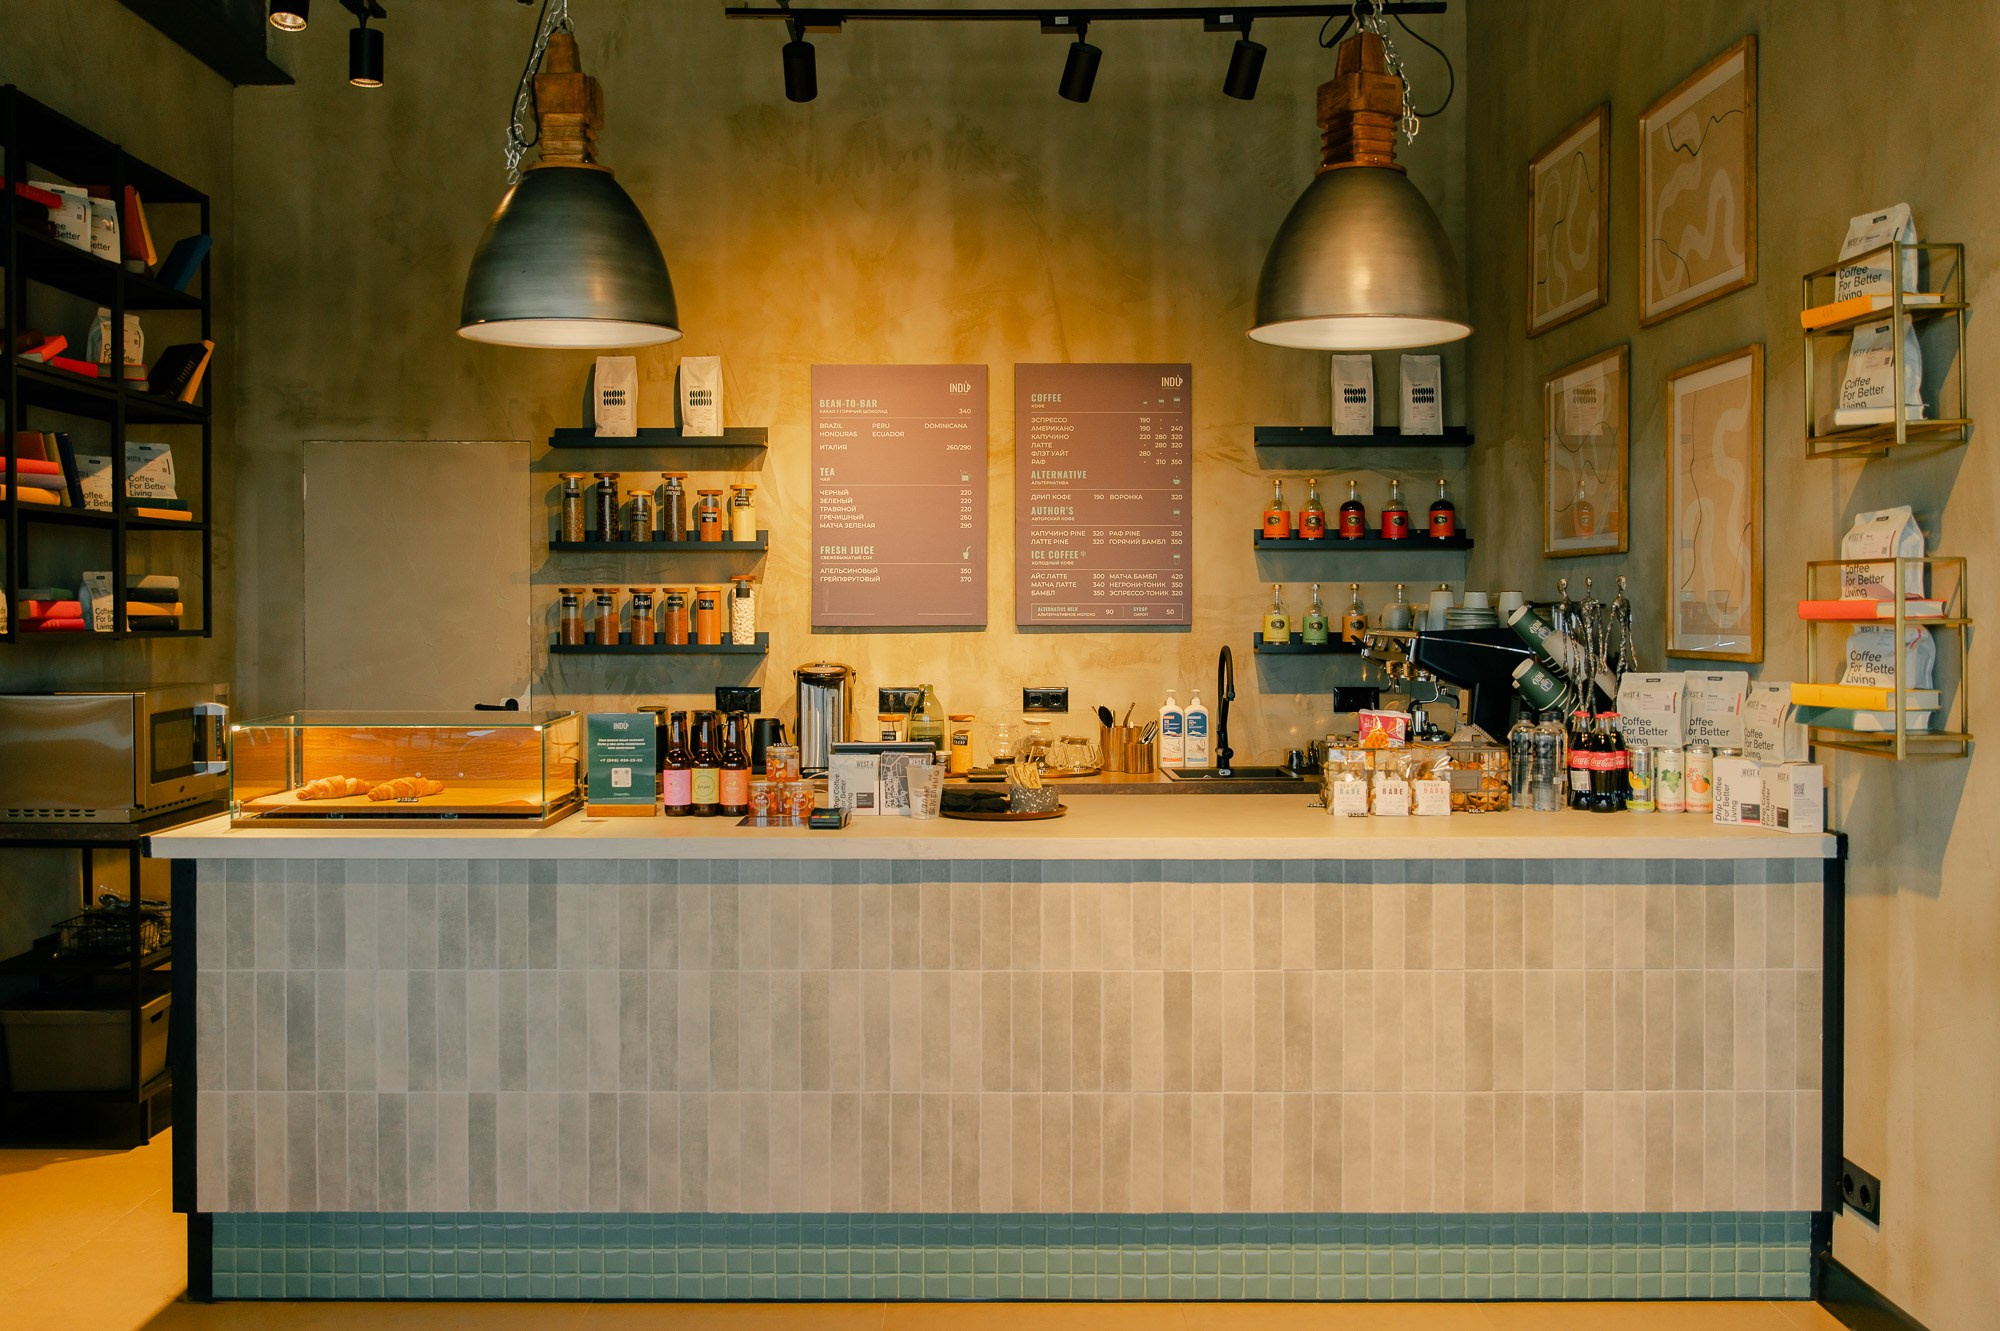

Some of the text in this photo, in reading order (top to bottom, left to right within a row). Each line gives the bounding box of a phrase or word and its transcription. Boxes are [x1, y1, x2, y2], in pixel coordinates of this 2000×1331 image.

[1840, 266, 1868, 279] Coffee
[1839, 274, 1882, 291] For Better
[1845, 377, 1870, 389] Coffee
[1031, 394, 1061, 402] COFFEE
[1843, 386, 1884, 401] For Better
[820, 468, 835, 476] TEA
[1031, 471, 1087, 479] ALTERNATIVE
[820, 546, 874, 554] FRESH JUICE
[1031, 551, 1045, 559] ICE
[1846, 564, 1870, 575] Coffee
[1846, 575, 1884, 586] For Better
[1845, 587, 1867, 598] Living
[635, 598, 650, 606] Brazil
[1850, 651, 1881, 661] Coffee
[1849, 662, 1894, 674] For Bette
[1846, 674, 1875, 686] Living
[1622, 717, 1652, 726] Coffee
[1690, 717, 1713, 726] offee
[1622, 726, 1668, 736] For Better
[1701, 727, 1729, 736] Better
[1744, 728, 1763, 738] Coffee
[1754, 740, 1774, 750] Better
[1744, 748, 1761, 760] Living
